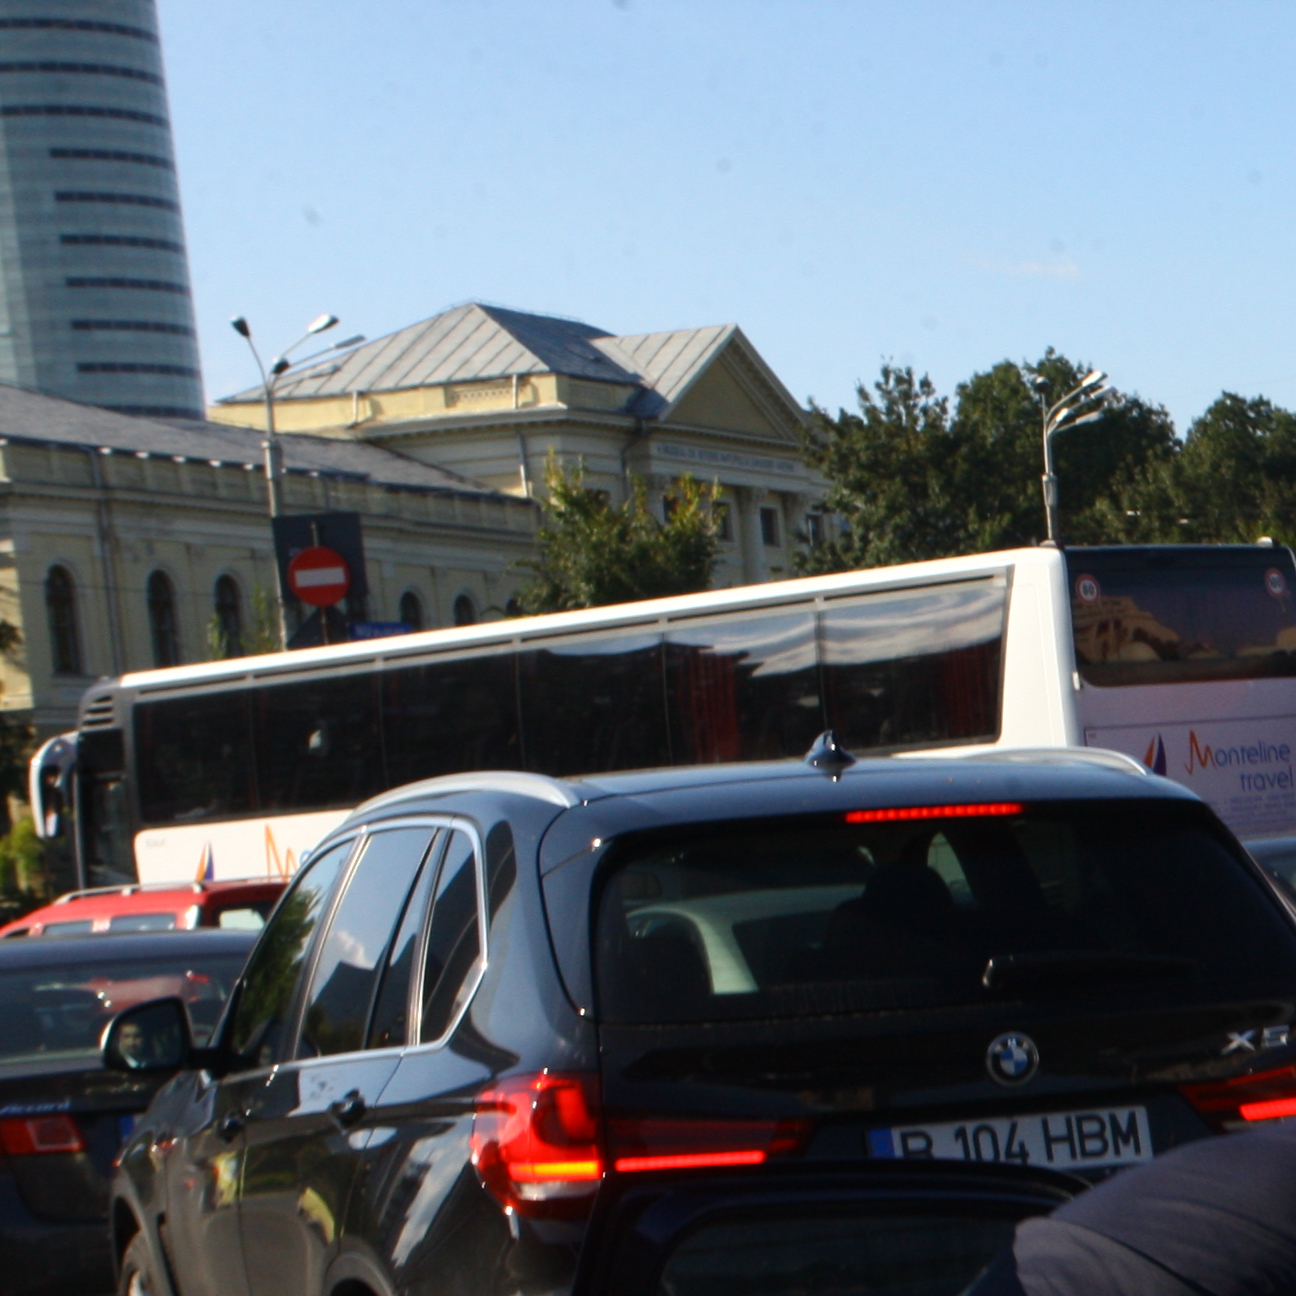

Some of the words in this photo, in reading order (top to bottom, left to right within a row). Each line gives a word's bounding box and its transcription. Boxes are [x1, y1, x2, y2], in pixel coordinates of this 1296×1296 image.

[1184, 729, 1291, 775] Monteline
[1240, 765, 1294, 791] travel
[1221, 1025, 1290, 1055] X5
[954, 1120, 1030, 1165] 104
[1041, 1110, 1142, 1162] HBM
